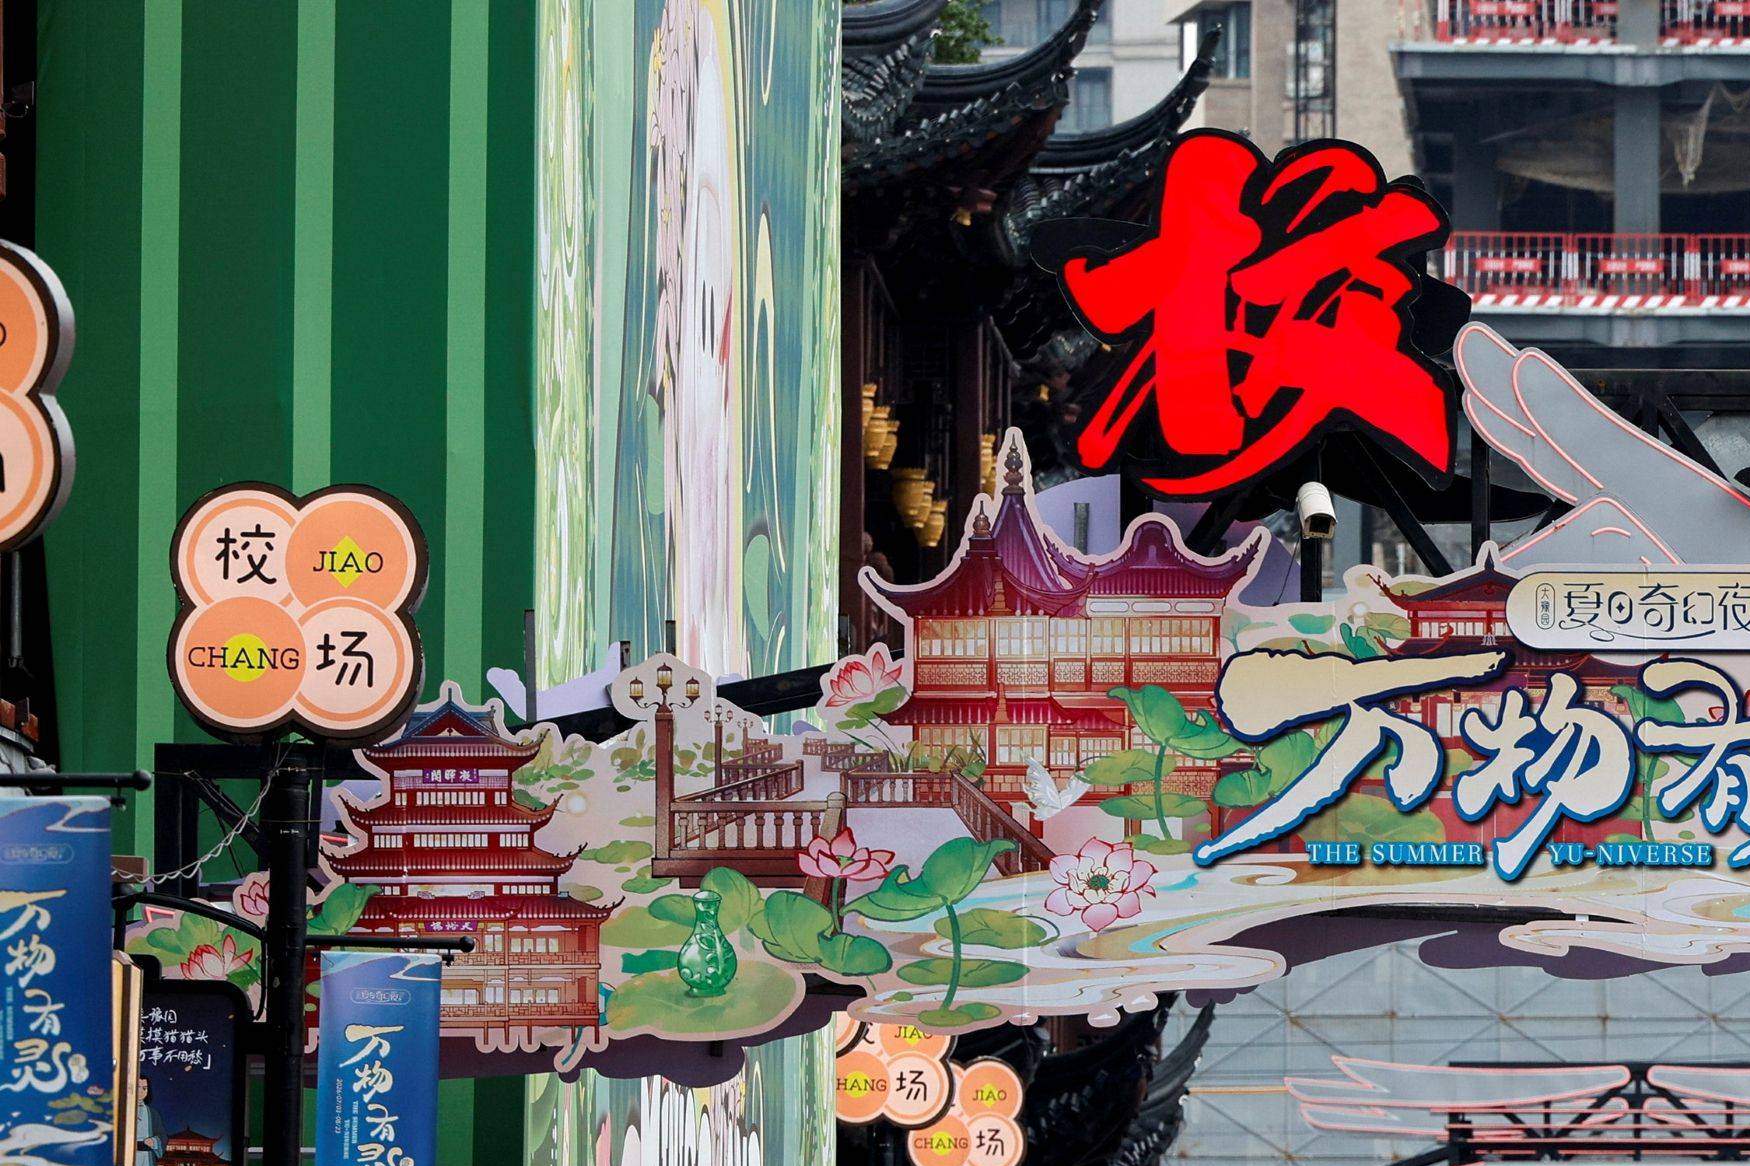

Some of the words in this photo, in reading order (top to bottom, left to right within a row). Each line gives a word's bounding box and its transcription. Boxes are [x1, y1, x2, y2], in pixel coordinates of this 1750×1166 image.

[215, 524, 277, 584] 校
[312, 550, 384, 574] JIAO
[188, 646, 300, 670] CHANG
[316, 631, 374, 688] 场
[1307, 843, 1361, 864] THE
[1371, 843, 1482, 865] SUMMER
[1549, 843, 1712, 865] YU-NIVERSE
[836, 1079, 887, 1092] HANG
[896, 1070, 927, 1102] 场
[972, 1090, 1007, 1101] JIAO
[914, 1137, 968, 1150] CHANG
[976, 1129, 1004, 1156] 场
